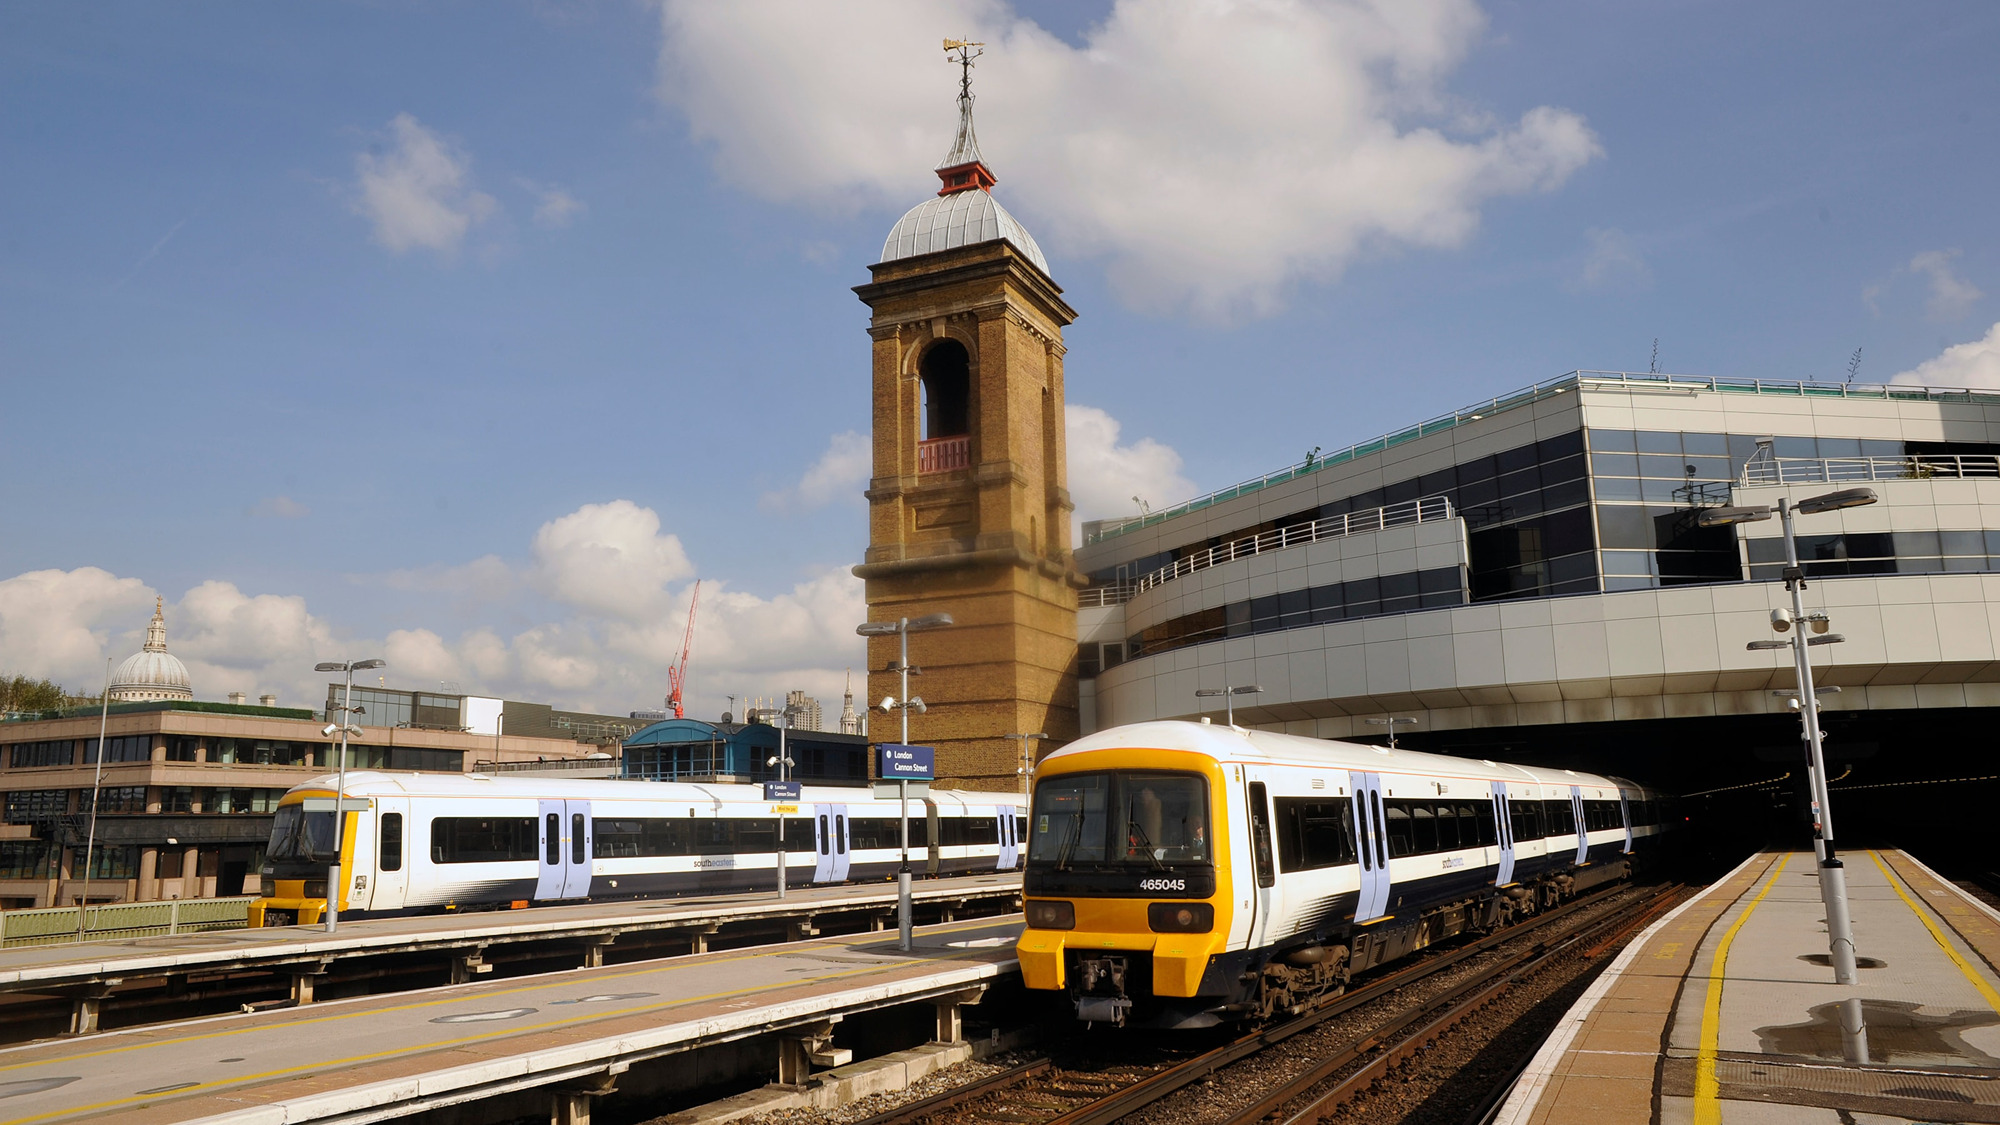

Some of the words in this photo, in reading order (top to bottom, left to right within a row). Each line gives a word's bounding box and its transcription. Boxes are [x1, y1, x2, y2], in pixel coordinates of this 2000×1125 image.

[894, 750, 913, 760] London
[894, 762, 913, 772] Cannon
[913, 763, 928, 772] Street
[1139, 879, 1186, 891] 465045
